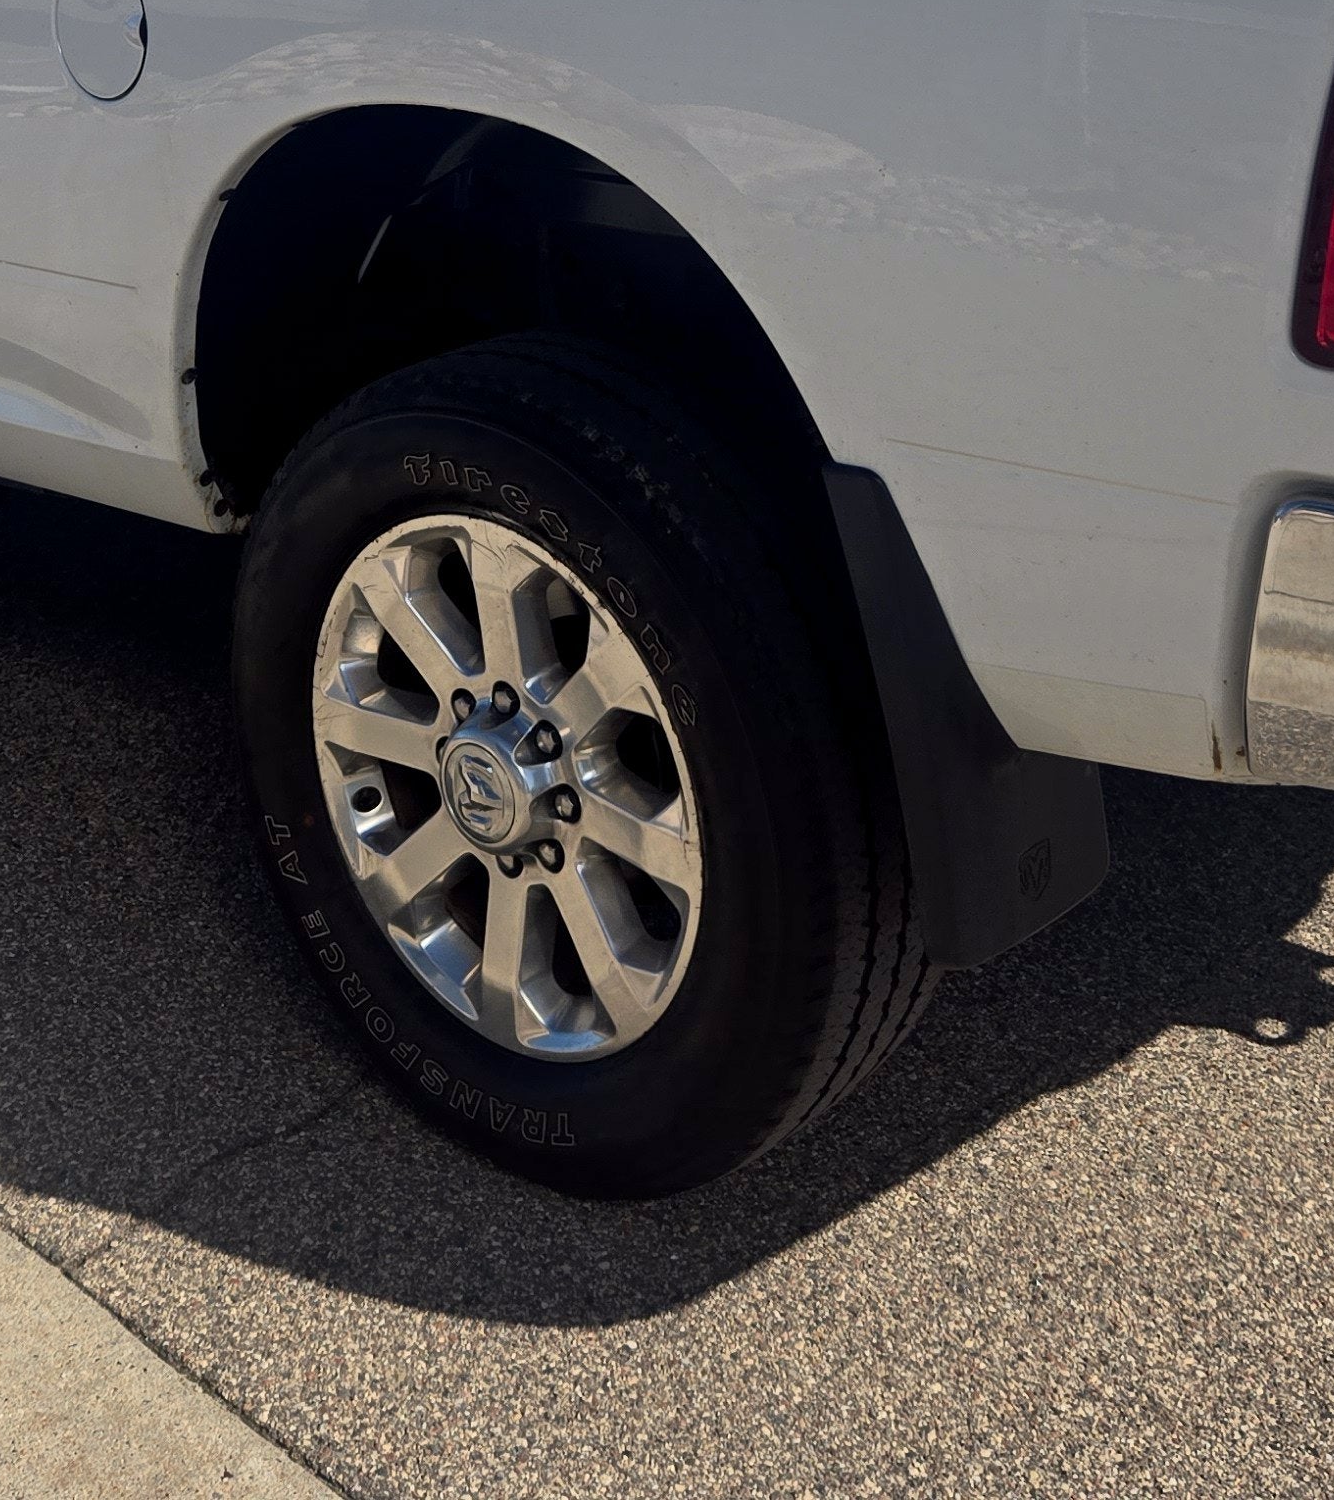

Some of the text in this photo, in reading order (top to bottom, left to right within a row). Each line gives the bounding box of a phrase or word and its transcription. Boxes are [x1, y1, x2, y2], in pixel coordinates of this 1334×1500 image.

[404, 454, 697, 726] Firestone
[264, 814, 575, 1147] TRANSFORCE AT
